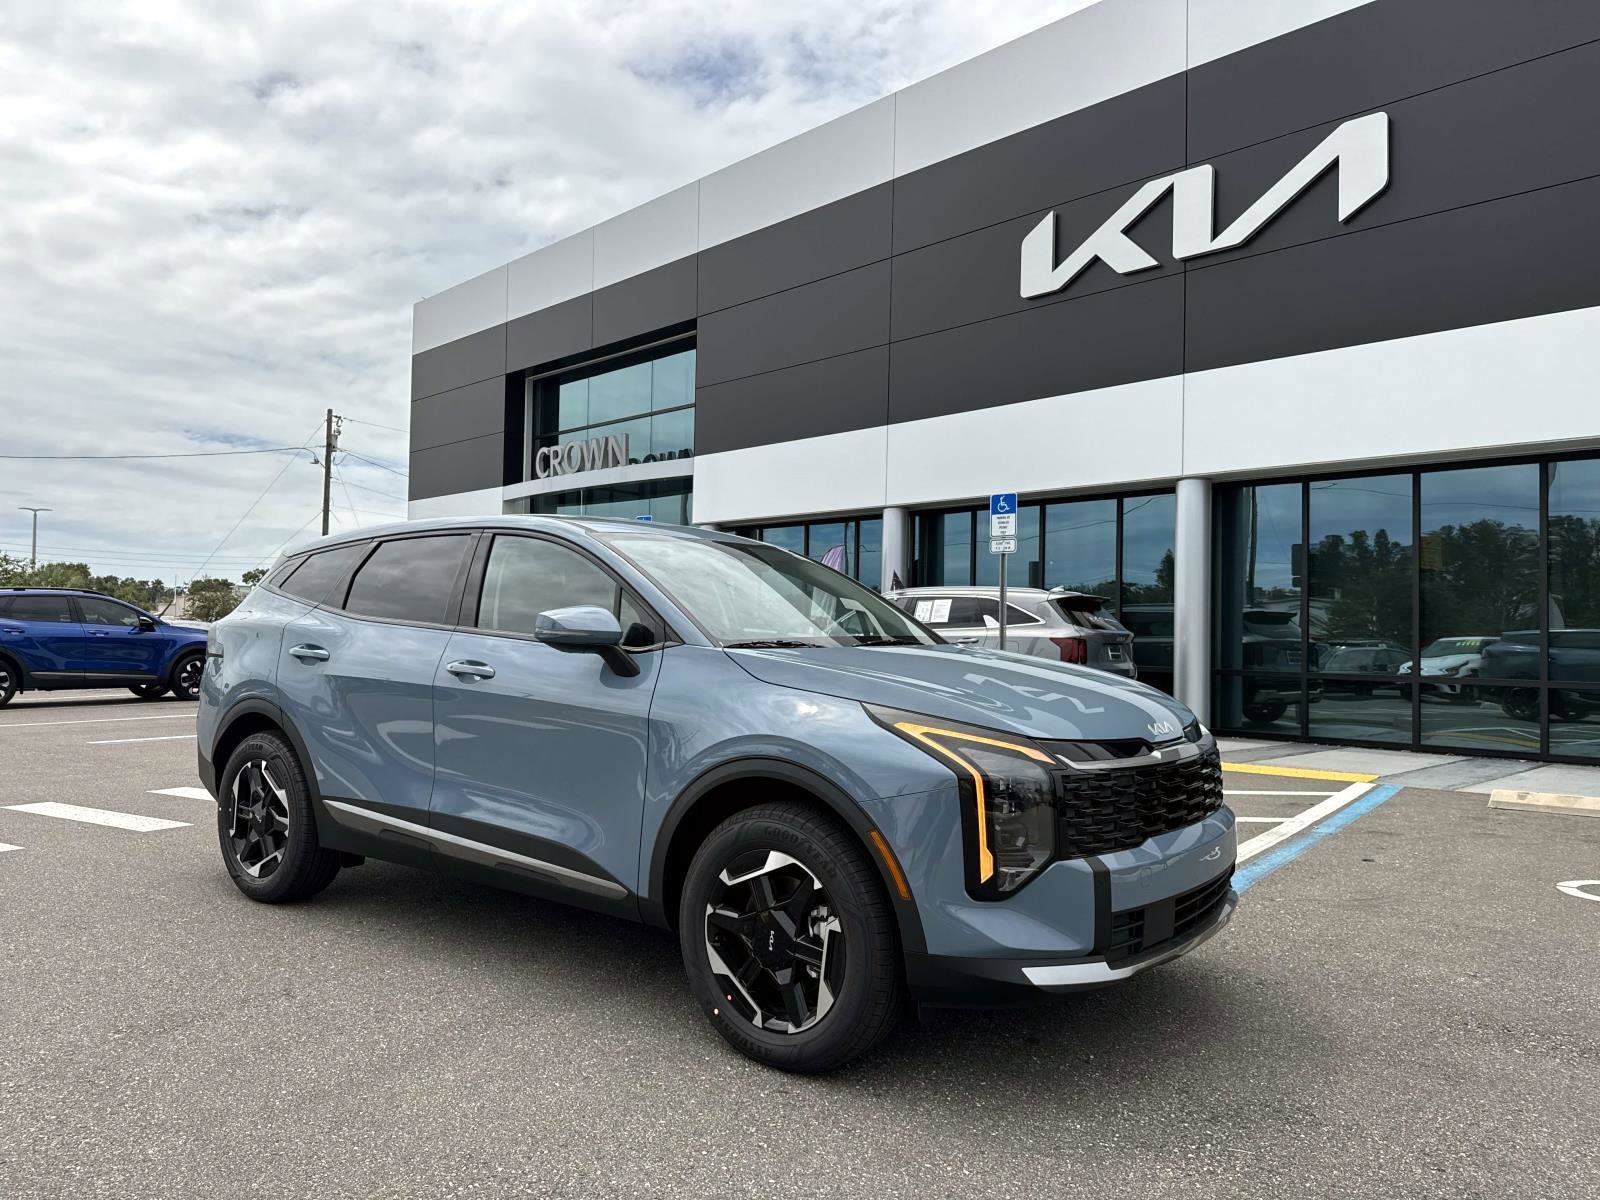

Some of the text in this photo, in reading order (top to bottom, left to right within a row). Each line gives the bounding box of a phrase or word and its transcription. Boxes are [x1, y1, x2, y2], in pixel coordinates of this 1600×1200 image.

[1020, 111, 1389, 299] KIA
[535, 432, 630, 480] CROWN
[1147, 721, 1174, 736] KIA
